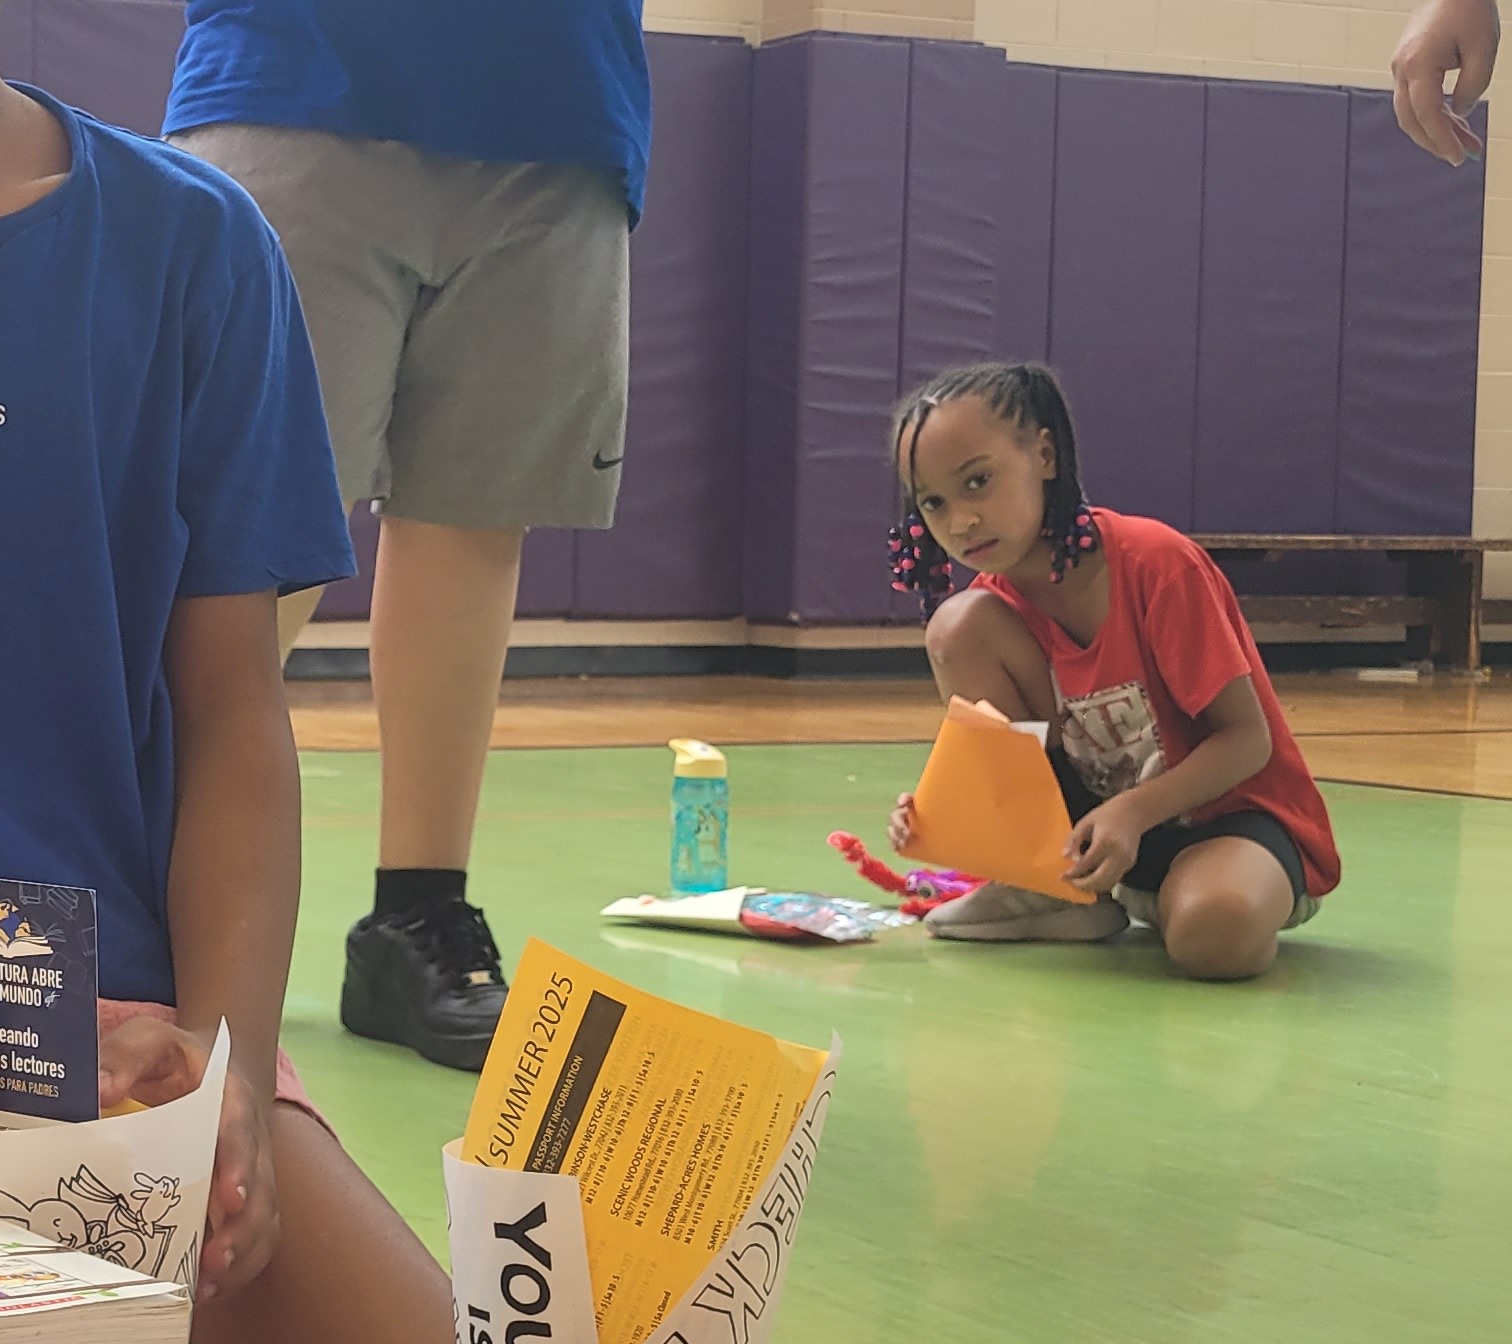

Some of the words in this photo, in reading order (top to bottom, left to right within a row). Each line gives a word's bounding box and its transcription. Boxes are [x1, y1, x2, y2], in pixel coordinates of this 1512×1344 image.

[31, 968, 64, 989] ABRE
[0, 986, 42, 1007] MUNDO
[11, 1050, 66, 1079] lectores
[489, 1040, 549, 1166] SUMMER
[532, 971, 573, 1043] 2025
[6, 1077, 28, 1093] PARA
[28, 1081, 59, 1098] PADRES
[531, 1119, 558, 1171] PASSPORT
[550, 1055, 584, 1122] INFORMATION
[610, 1182, 627, 1217] SCENIC
[624, 1145, 646, 1184] WOODS
[639, 1097, 668, 1147] REGIONAL
[660, 1159, 697, 1237] SHEPARD-ACRES
[691, 1122, 712, 1158] HOMES
[707, 1219, 725, 1251] SMITH
